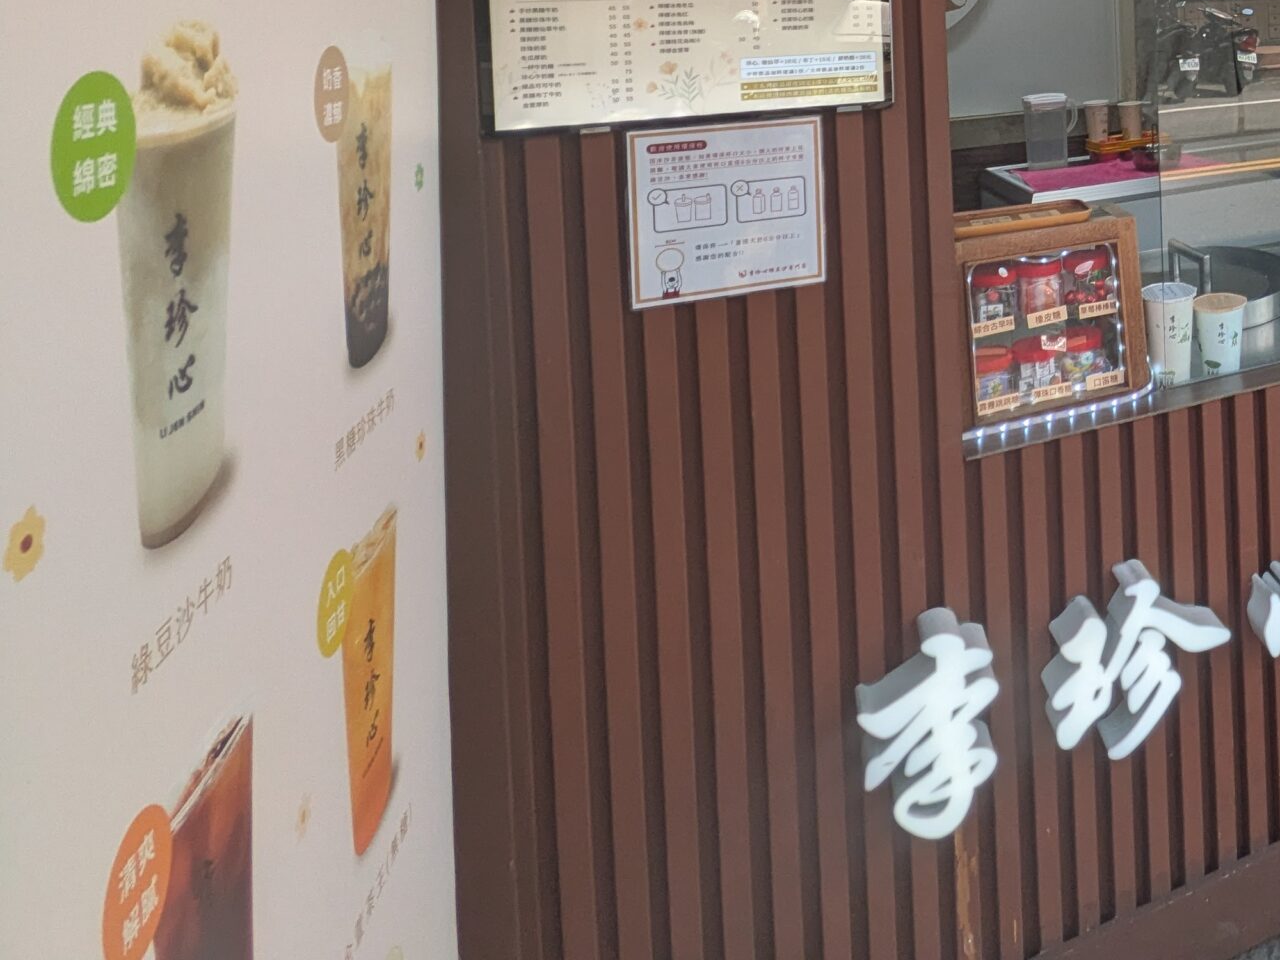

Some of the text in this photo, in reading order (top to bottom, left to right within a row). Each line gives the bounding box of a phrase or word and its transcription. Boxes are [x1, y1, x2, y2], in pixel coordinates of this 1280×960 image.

[72, 99, 118, 142] 經典
[72, 152, 118, 198] 綿密
[355, 122, 375, 260] 李珍心
[163, 212, 199, 401] 李珍心
[1035, 311, 1062, 325] 橡皮糖
[1093, 375, 1119, 387] 口笛糖
[327, 564, 347, 609] 入口
[130, 555, 234, 695] 綠豆沙牛奶
[119, 828, 156, 904] 清爽
